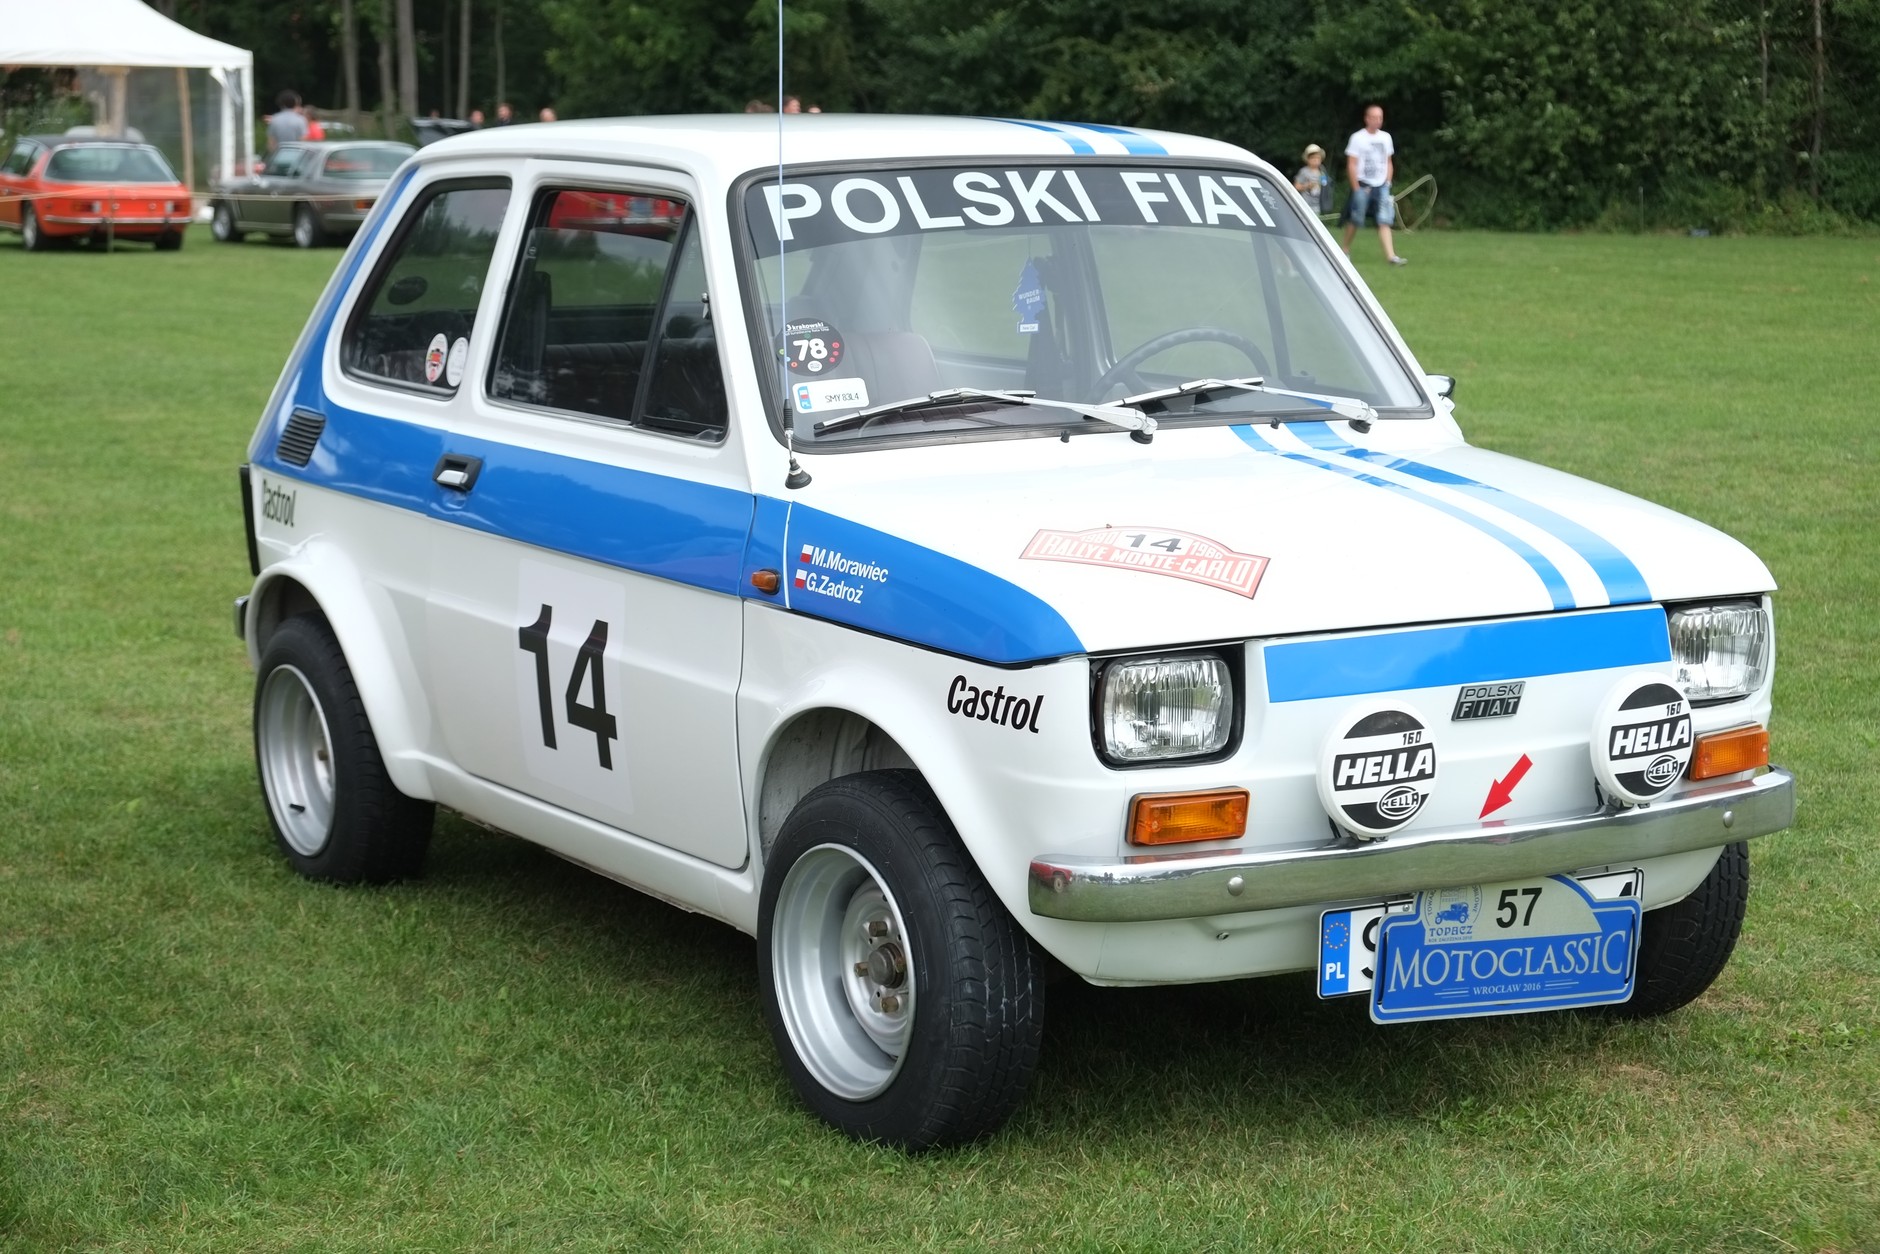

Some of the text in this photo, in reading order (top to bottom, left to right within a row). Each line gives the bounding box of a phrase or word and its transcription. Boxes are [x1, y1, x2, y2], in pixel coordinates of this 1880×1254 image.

[762, 170, 1276, 240] POLSKI FIAT
[793, 338, 828, 361] 78
[1125, 534, 1181, 552] 14
[811, 547, 889, 583] M.Morawiec
[1040, 534, 1251, 585] RALLYE MONTE-CARLO
[806, 572, 864, 604] G.Zadroż
[518, 603, 618, 771] 14
[1464, 684, 1523, 700] POLSKI
[947, 674, 1044, 734] Castrol
[1458, 698, 1519, 717] FIAT
[1666, 702, 1681, 716] 160
[1402, 731, 1422, 745] 160
[1611, 719, 1690, 756] HELLA
[1336, 748, 1433, 786] HELLA
[1648, 761, 1679, 776] HELLA
[1382, 792, 1420, 808] HELLA
[1496, 887, 1542, 928] 57
[1325, 961, 1346, 981] PL
[1388, 930, 1626, 992] MOTOCLASSIC
[1522, 982, 1541, 992] 2016
